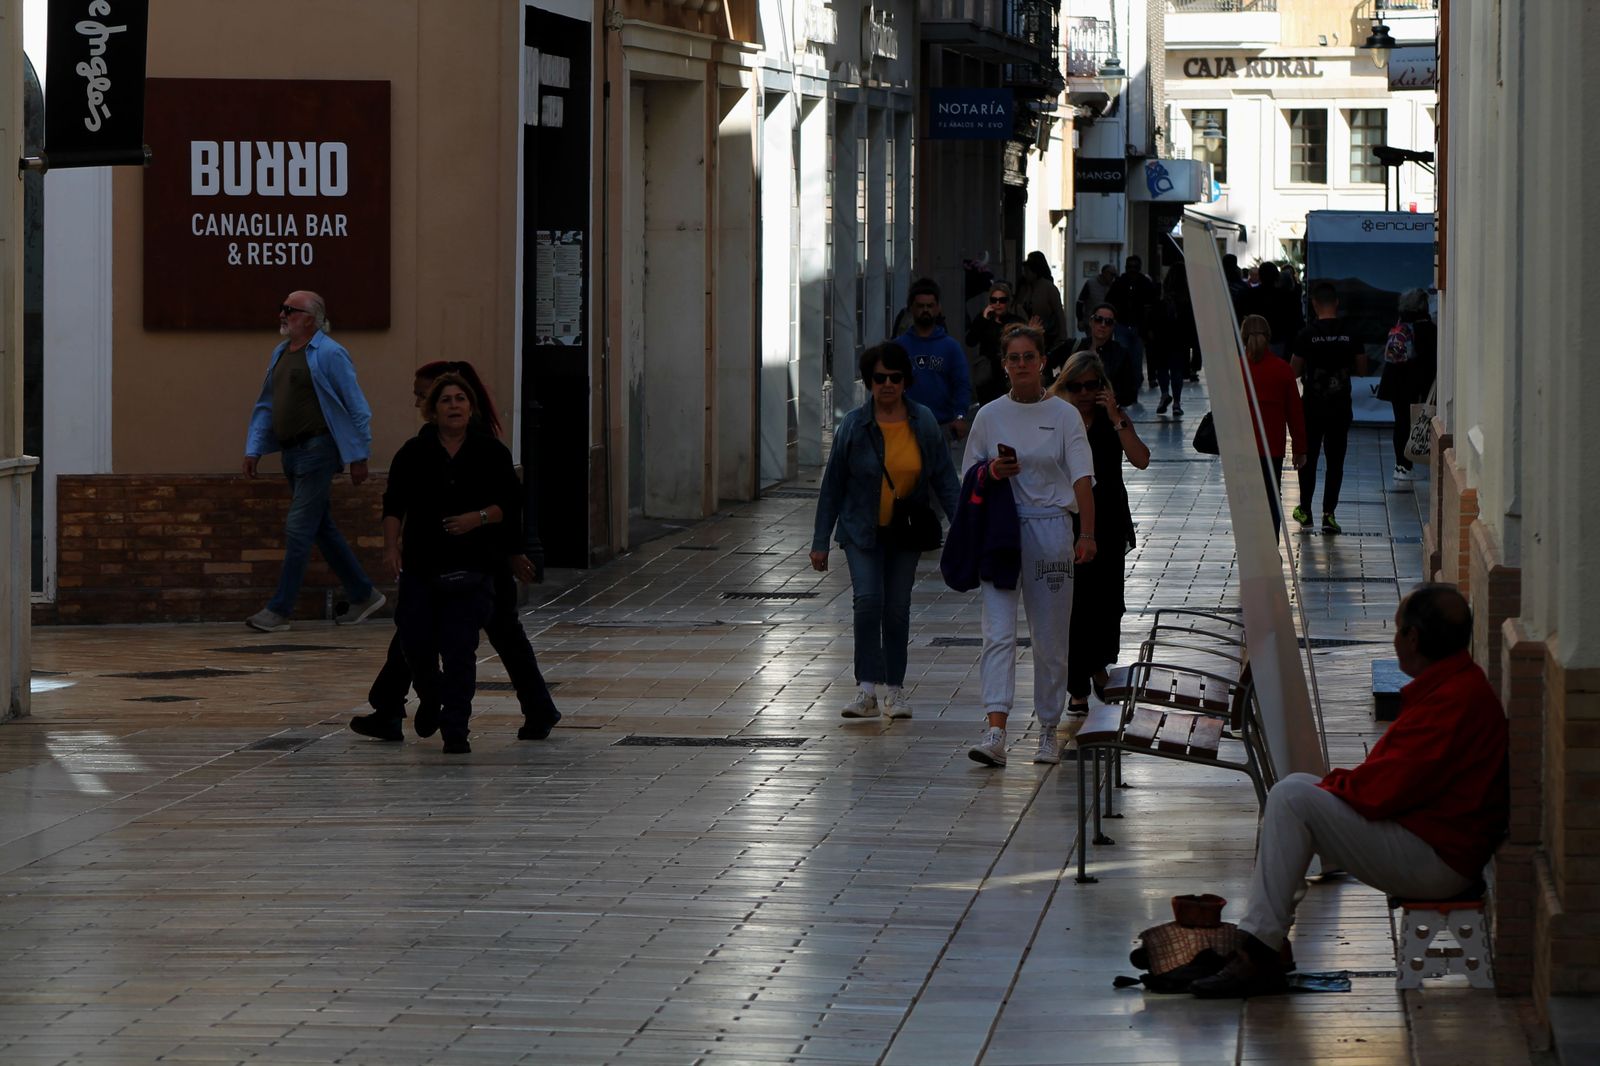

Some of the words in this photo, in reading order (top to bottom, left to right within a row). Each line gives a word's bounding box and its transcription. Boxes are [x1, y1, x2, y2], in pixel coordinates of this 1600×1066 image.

[1183, 57, 1239, 79] CAJA
[1245, 57, 1324, 79] RURAL
[938, 100, 1006, 115] NOTARÍA
[190, 140, 349, 197] BURRO
[1076, 170, 1122, 180] MANGO
[191, 213, 299, 237] CANAGLIA
[306, 213, 349, 237] BAR
[227, 242, 242, 266] &
[247, 242, 314, 266] RESTO
